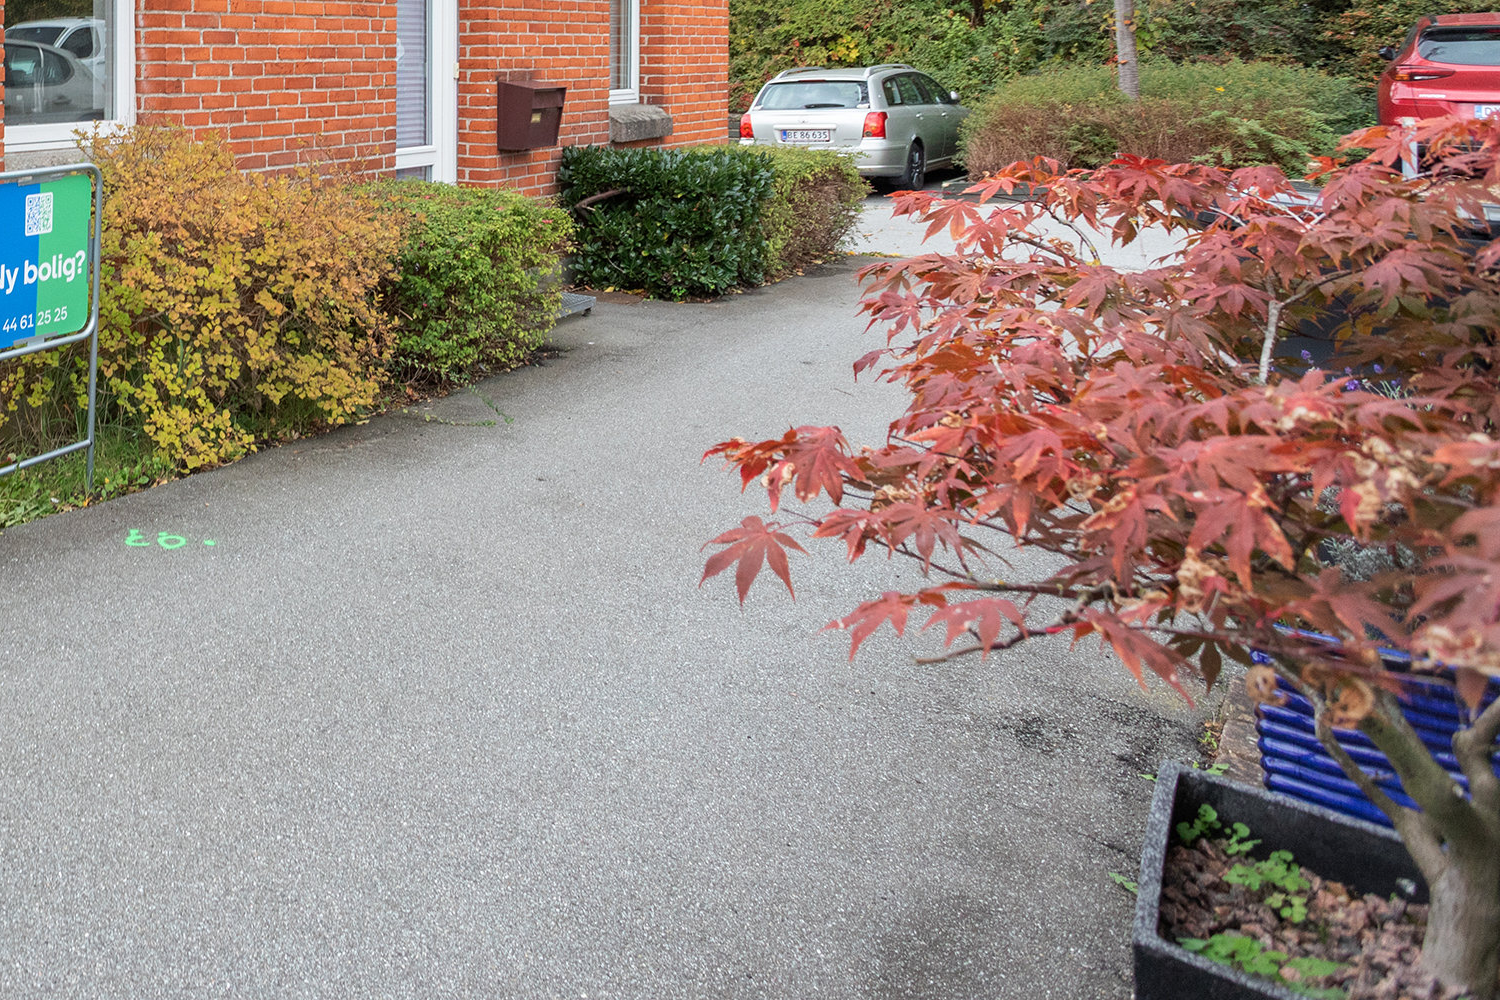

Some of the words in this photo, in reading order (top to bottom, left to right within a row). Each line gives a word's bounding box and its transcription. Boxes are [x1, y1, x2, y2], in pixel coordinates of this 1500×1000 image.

[787, 131, 798, 139] BE
[800, 131, 810, 139] 86
[812, 131, 828, 139] 635
[23, 249, 86, 285] bolig?
[2, 317, 17, 333] 44
[20, 313, 34, 330] 61
[37, 309, 51, 326] 25
[54, 306, 68, 322] 25
